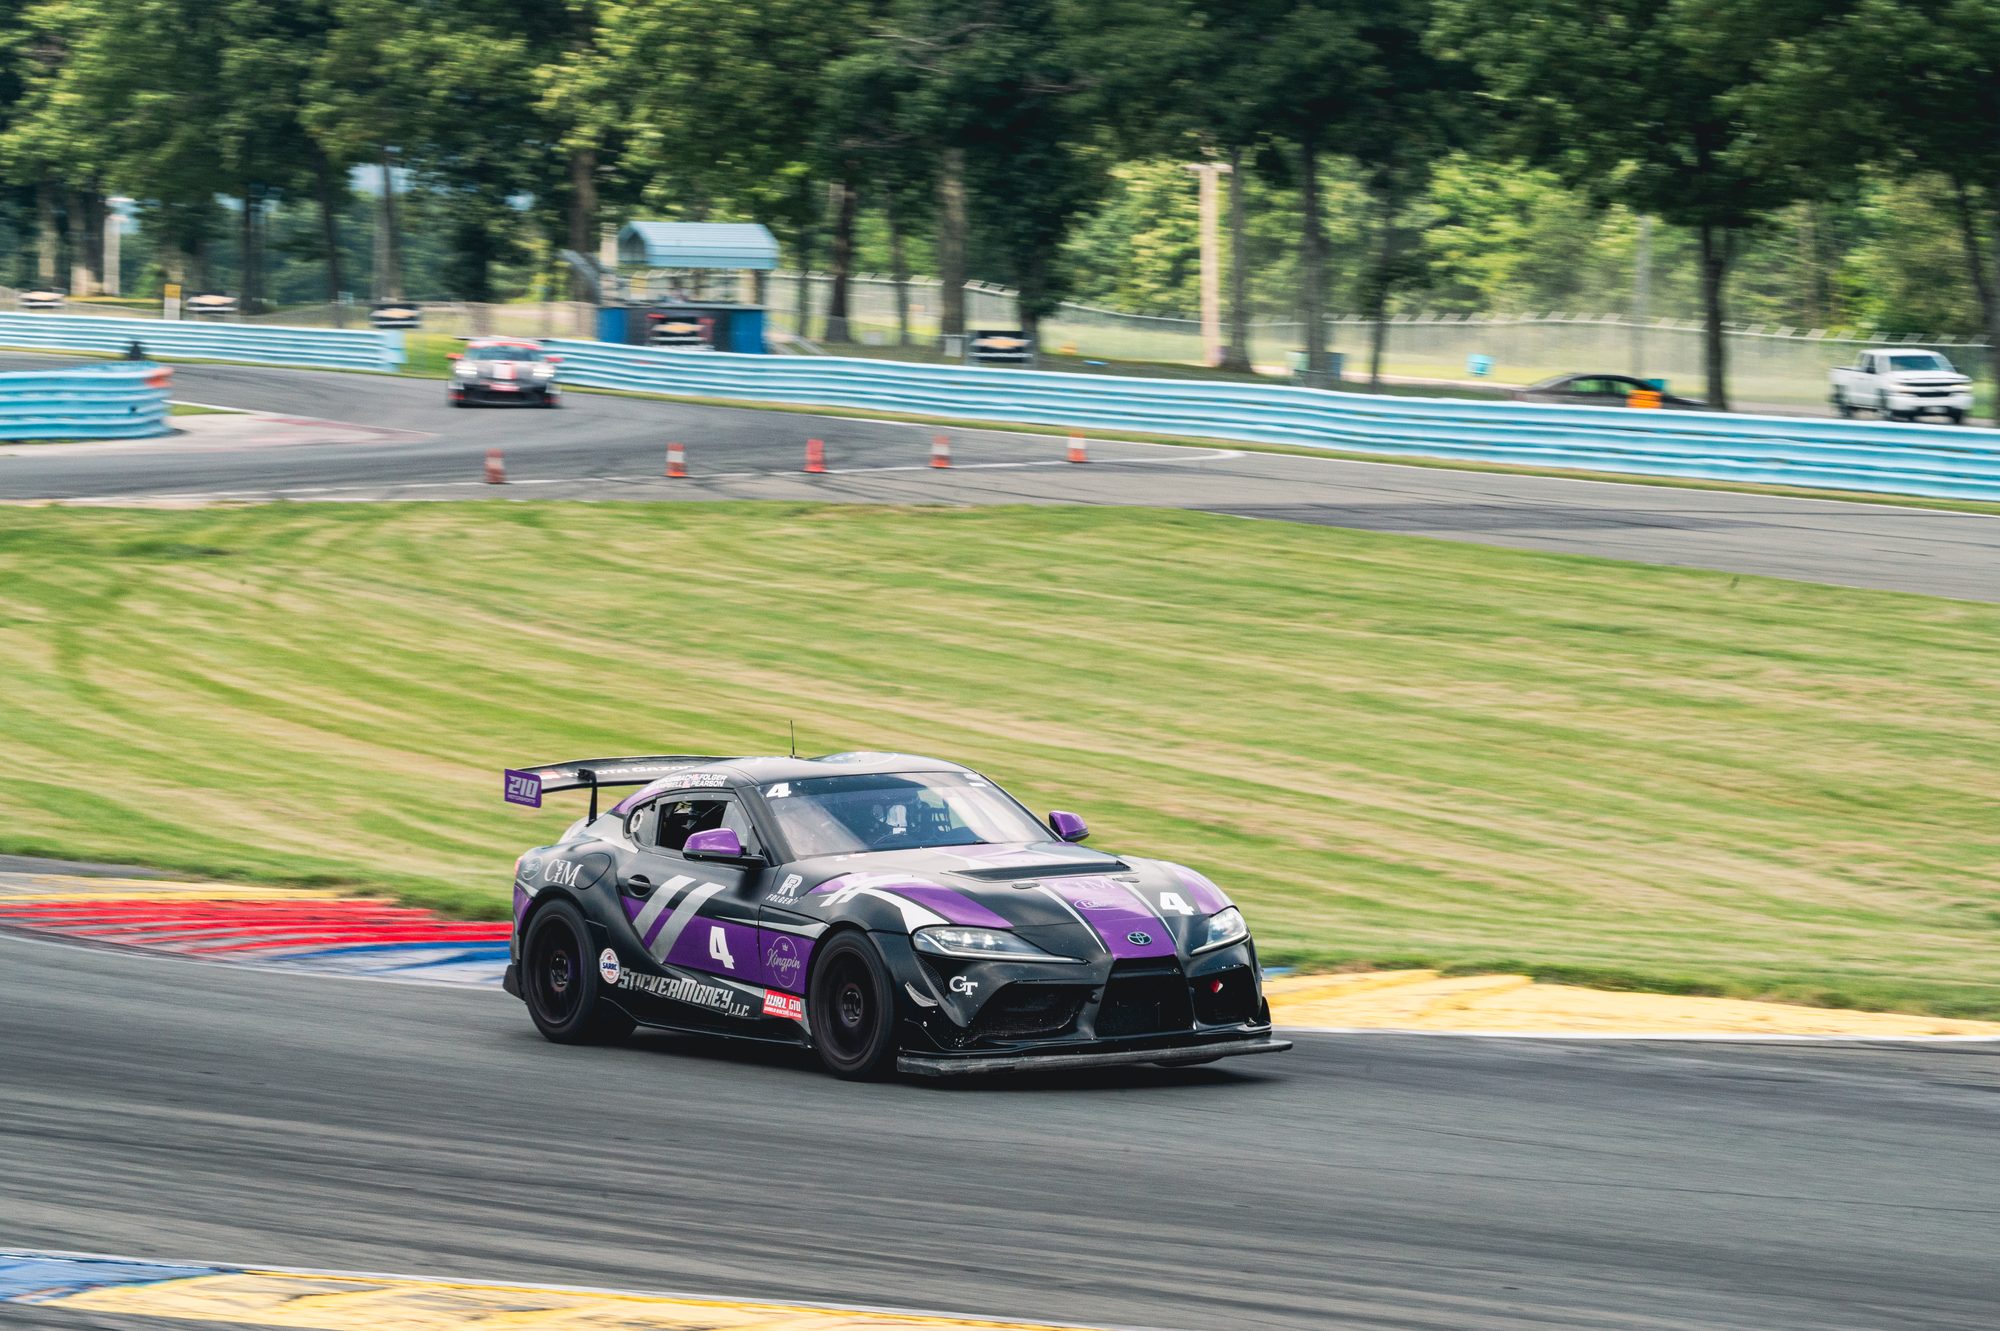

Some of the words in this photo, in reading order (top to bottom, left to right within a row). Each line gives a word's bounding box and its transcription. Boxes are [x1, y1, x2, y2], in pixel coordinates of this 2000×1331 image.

[561, 768, 629, 778] TOTA
[700, 773, 728, 781] FOLGER
[508, 775, 540, 798] 210
[766, 783, 792, 798] 4
[1159, 891, 1195, 916] 4
[709, 925, 735, 970] 4
[766, 948, 800, 972] Kingpin
[949, 975, 979, 996] GT
[765, 994, 787, 1009] WRL
